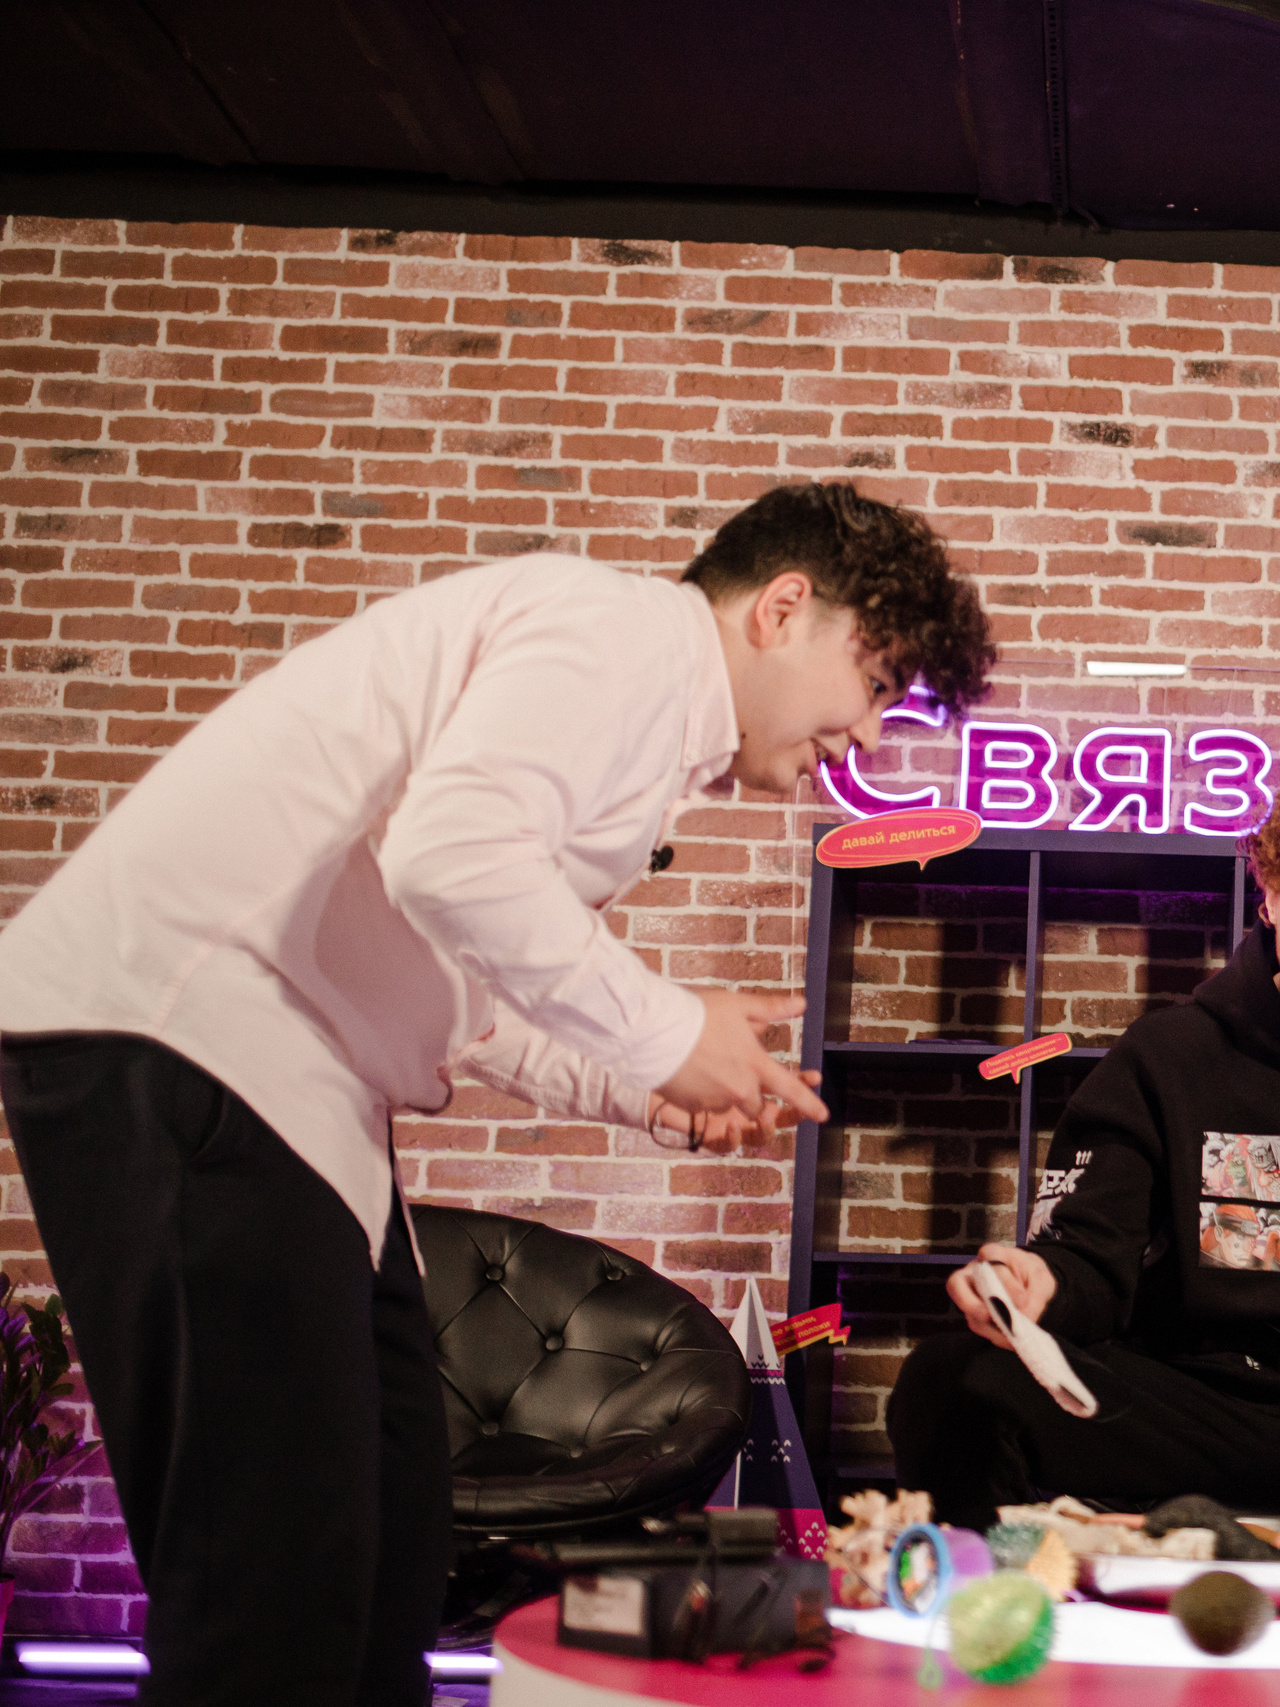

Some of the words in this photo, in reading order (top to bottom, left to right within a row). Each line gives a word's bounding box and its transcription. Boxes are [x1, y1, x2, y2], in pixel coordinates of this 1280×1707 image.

[841, 832, 885, 850] давай
[889, 825, 956, 844] делиться
[797, 1321, 831, 1338] положи
